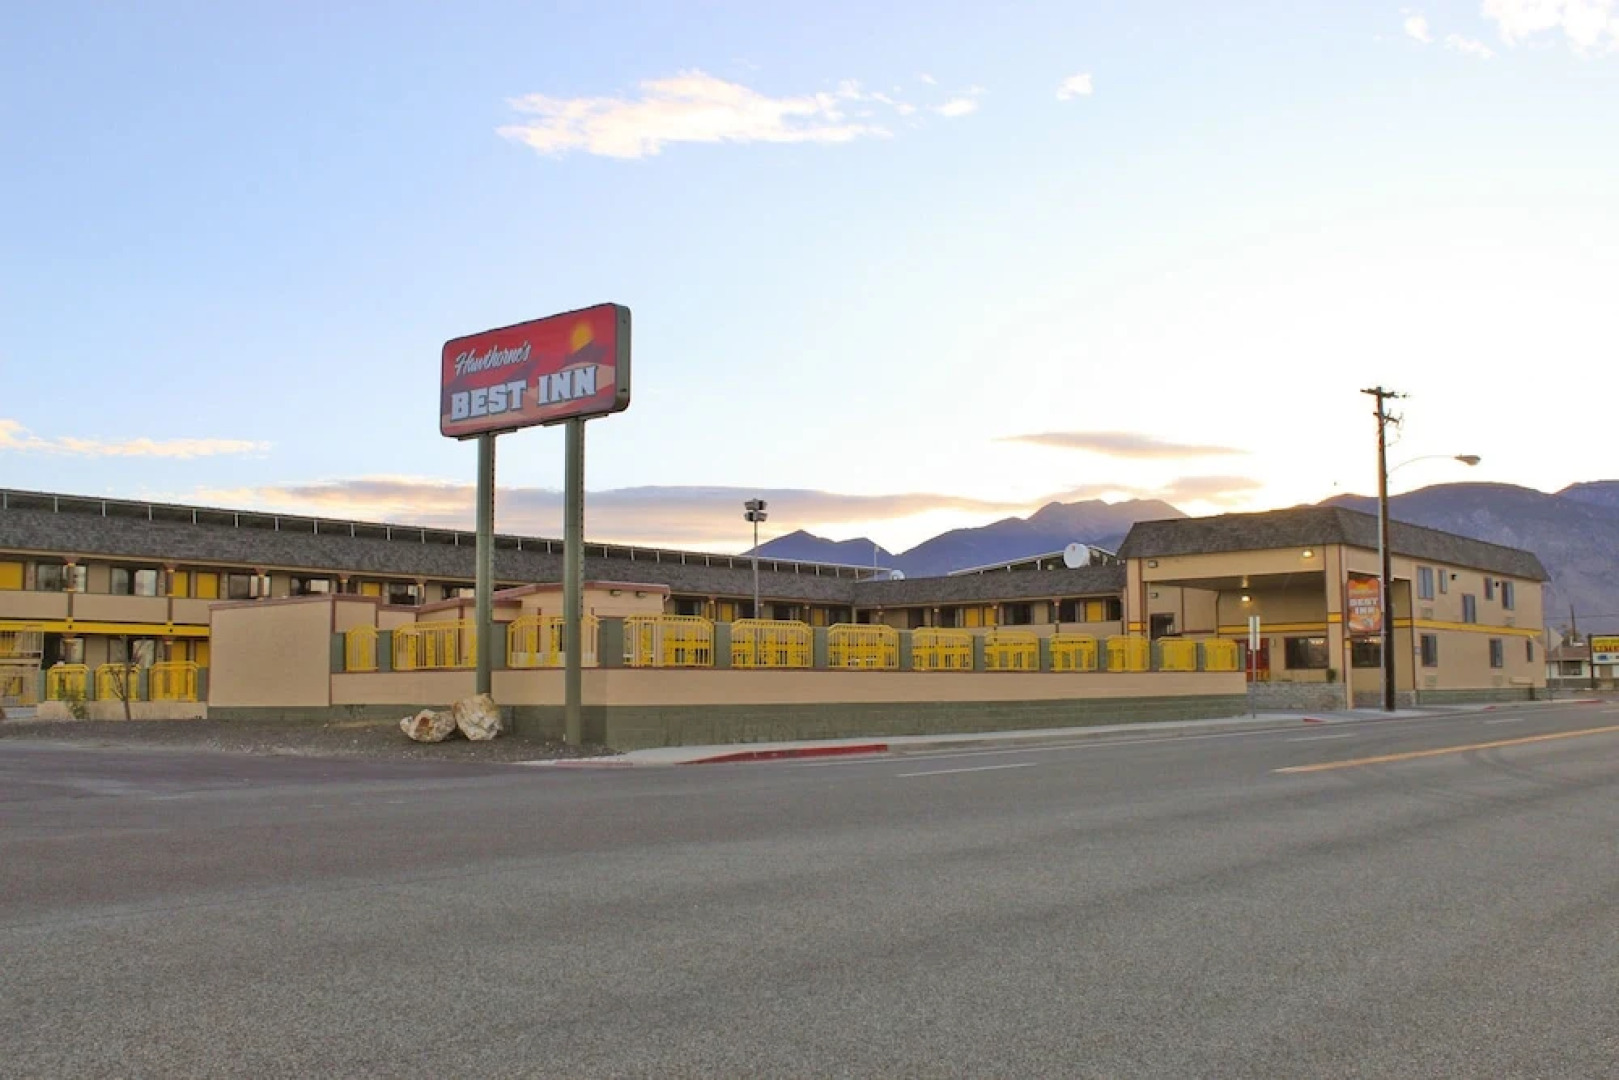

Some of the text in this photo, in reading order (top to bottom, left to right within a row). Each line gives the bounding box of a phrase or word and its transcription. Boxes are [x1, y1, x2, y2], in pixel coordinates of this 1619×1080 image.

[454, 339, 532, 377] Hawthorne's
[451, 365, 598, 421] BEST INN
